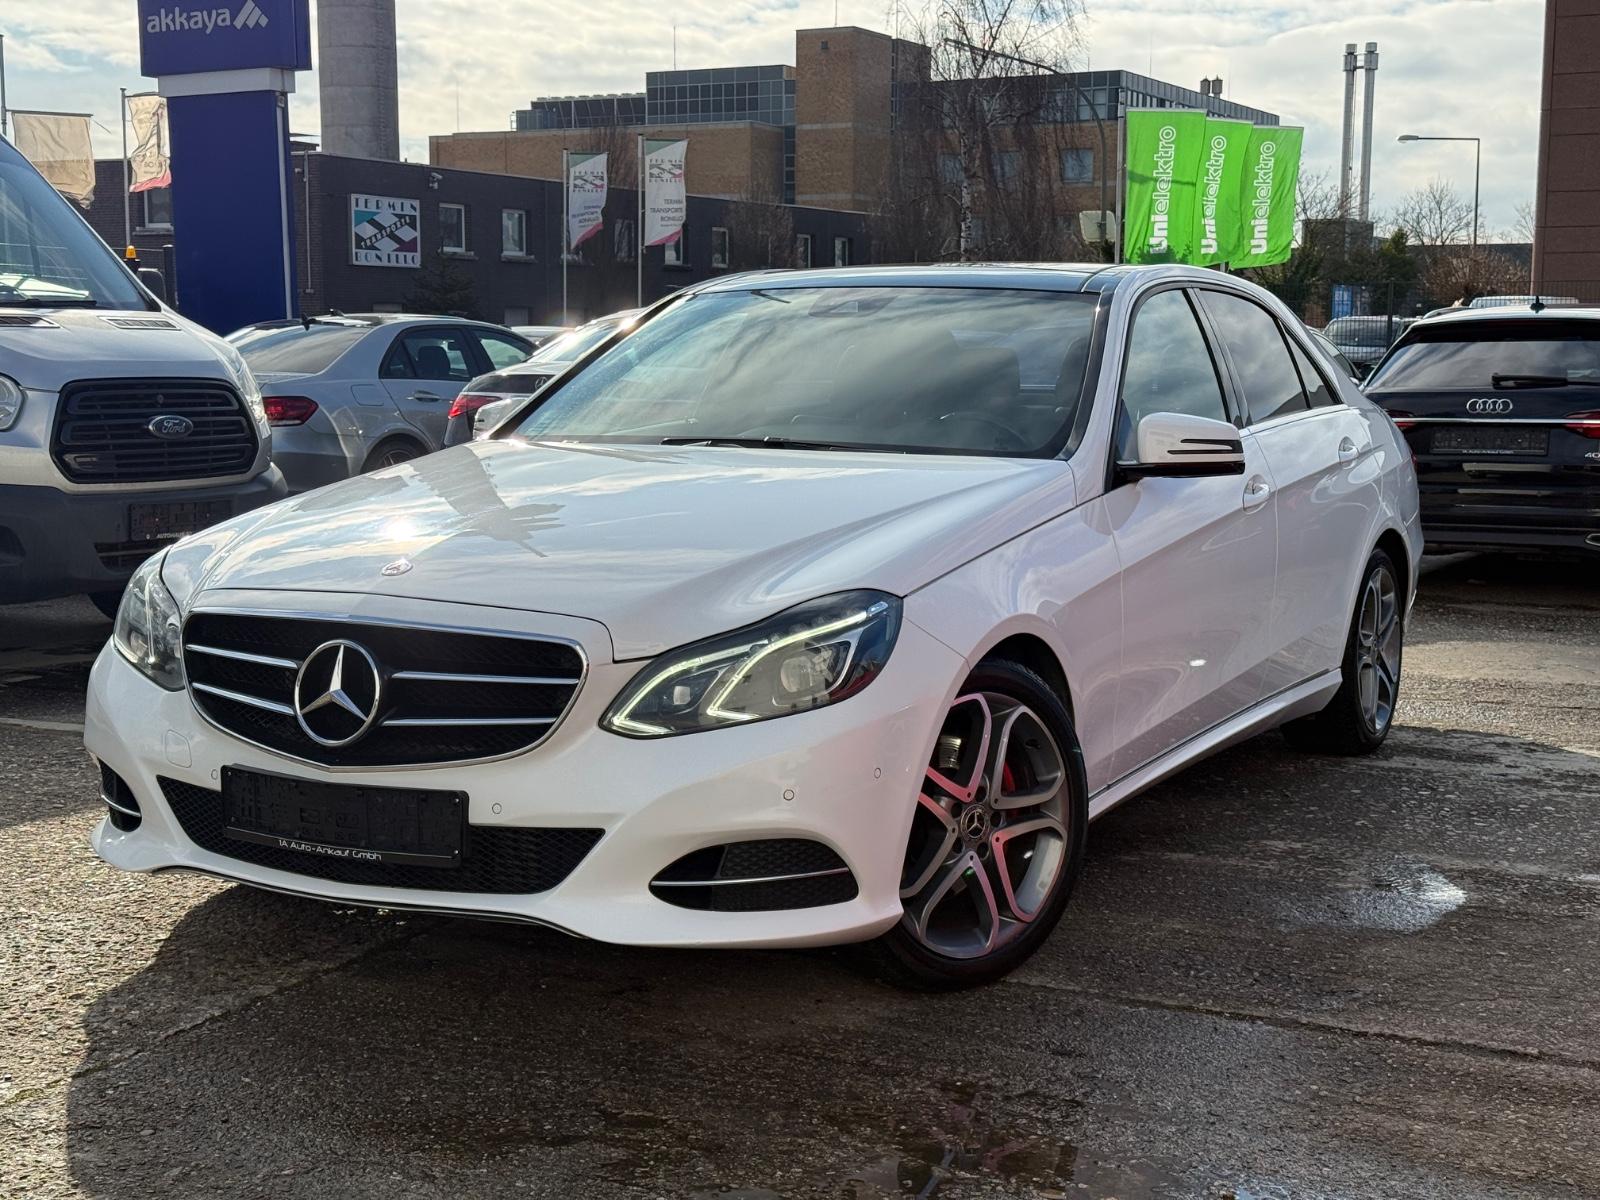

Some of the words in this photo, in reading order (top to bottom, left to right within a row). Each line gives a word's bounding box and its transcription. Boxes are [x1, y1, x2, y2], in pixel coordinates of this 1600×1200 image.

[146, 6, 231, 35] akkaya
[162, 419, 187, 433] Ford
[279, 839, 289, 848] 1A
